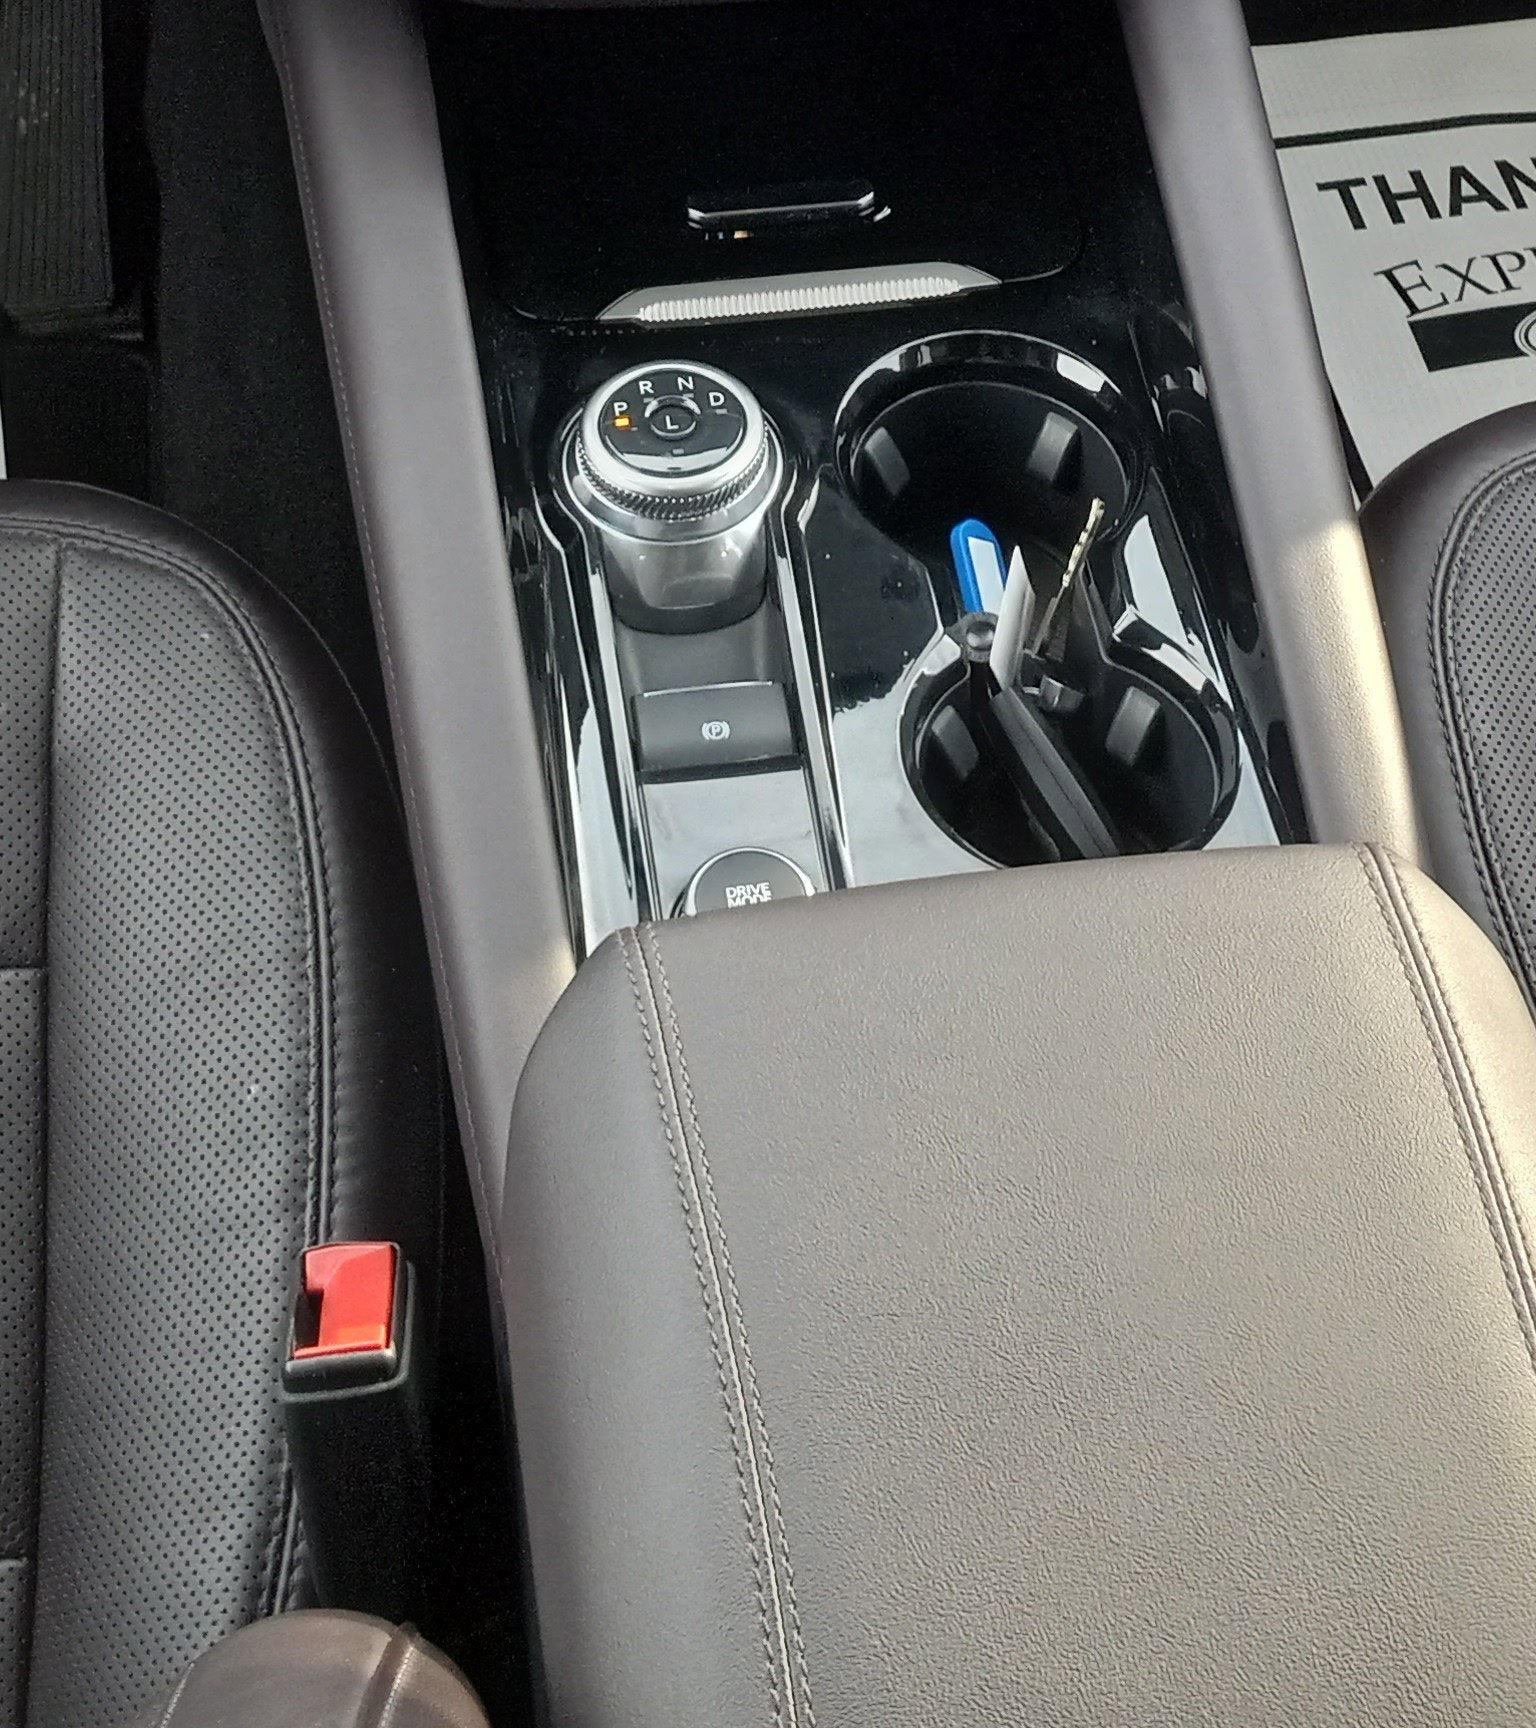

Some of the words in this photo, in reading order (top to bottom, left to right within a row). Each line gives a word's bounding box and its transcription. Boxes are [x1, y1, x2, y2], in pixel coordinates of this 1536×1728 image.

[638, 380, 655, 396] R
[677, 376, 695, 391] N
[708, 392, 726, 407] D
[613, 402, 629, 417] P
[664, 414, 680, 430] L
[725, 882, 770, 899] DRIVE
